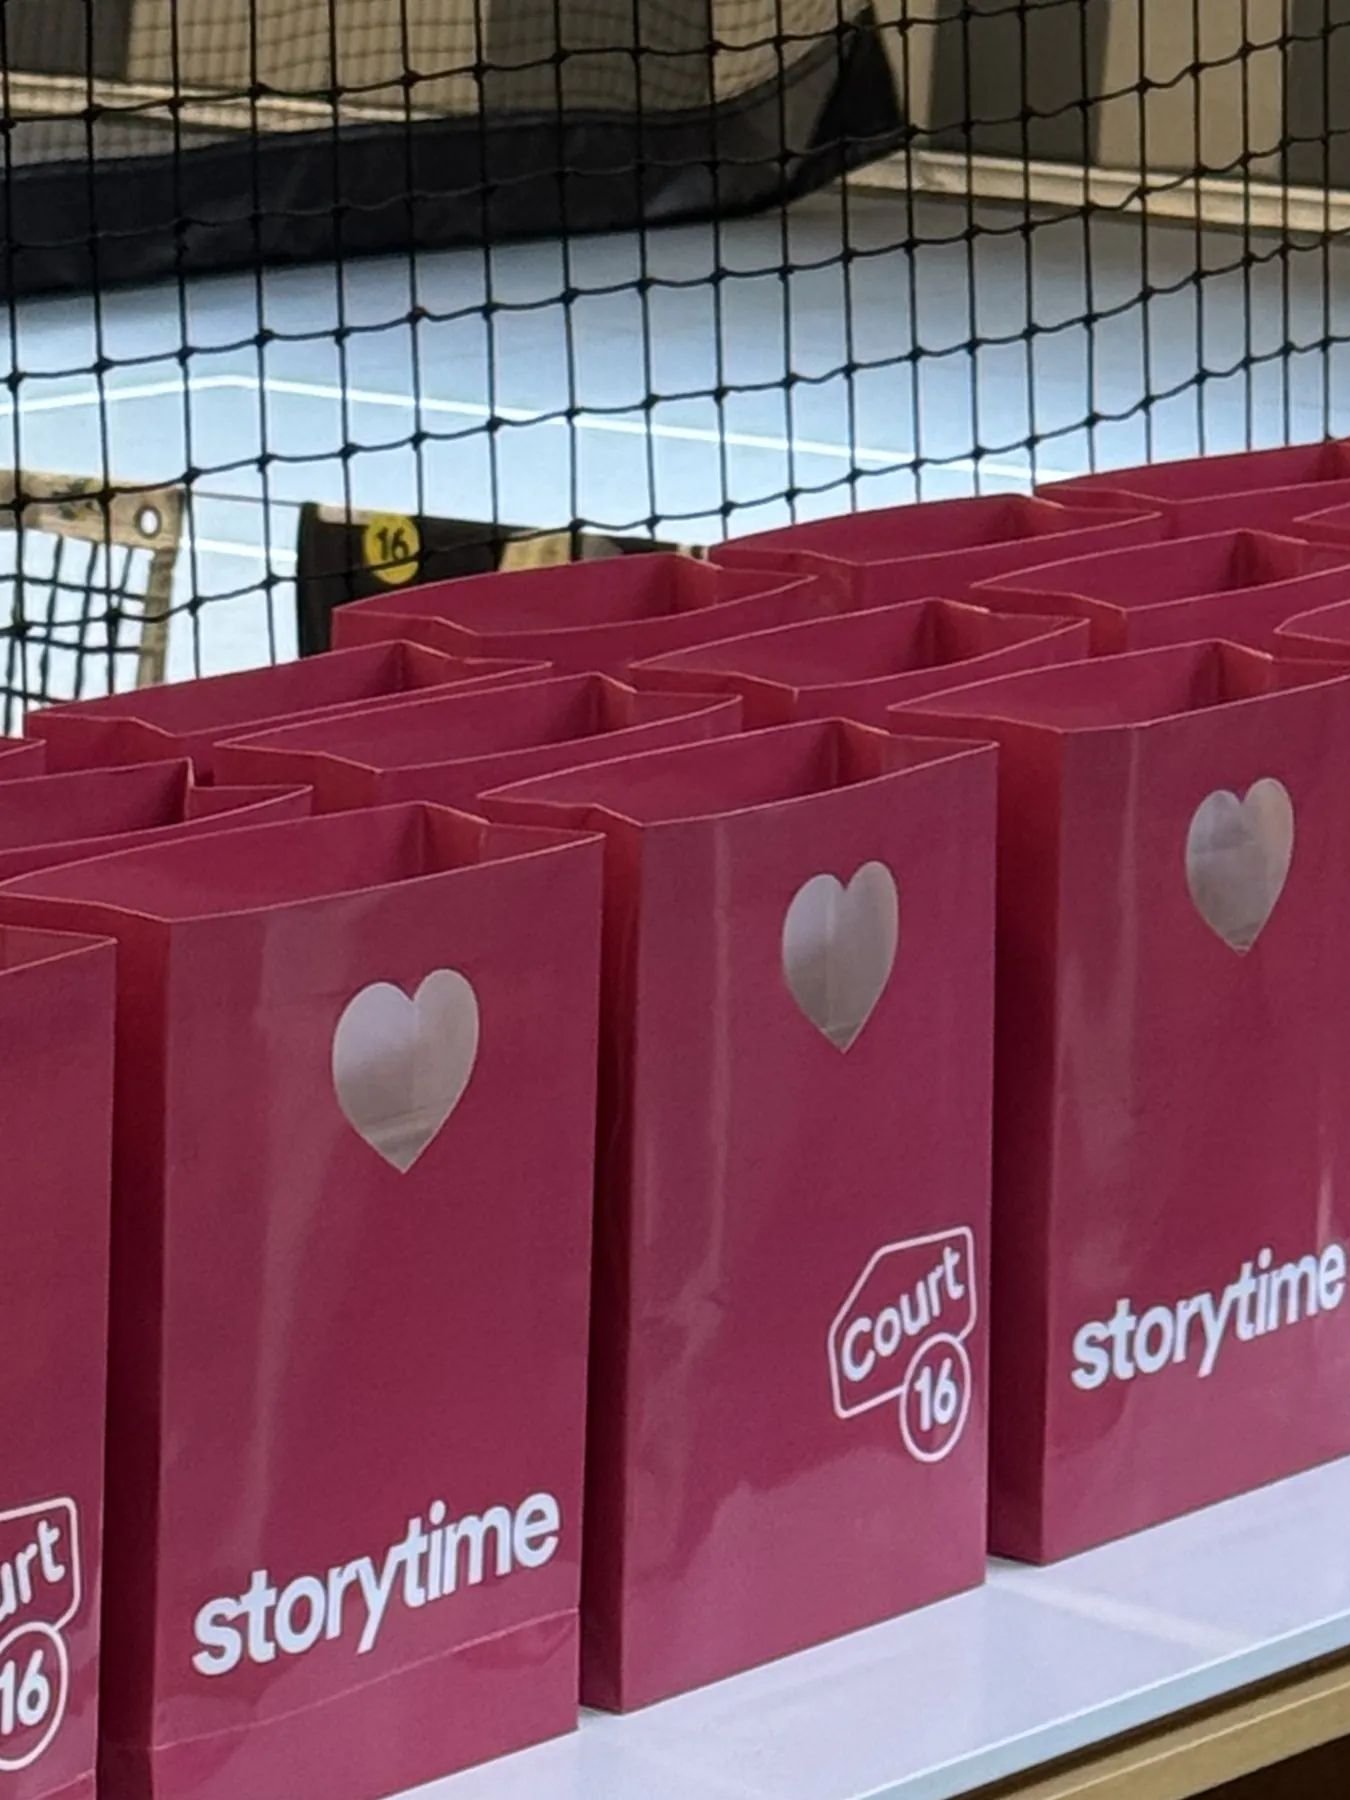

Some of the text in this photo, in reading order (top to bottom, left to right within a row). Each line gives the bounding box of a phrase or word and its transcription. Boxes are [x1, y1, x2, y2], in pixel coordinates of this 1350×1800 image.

[376, 526, 409, 561] 16
[1071, 1243, 1347, 1390] storytime
[913, 1358, 957, 1431] 16
[192, 1493, 560, 1676] storytime
[0, 1649, 50, 1735] 16
